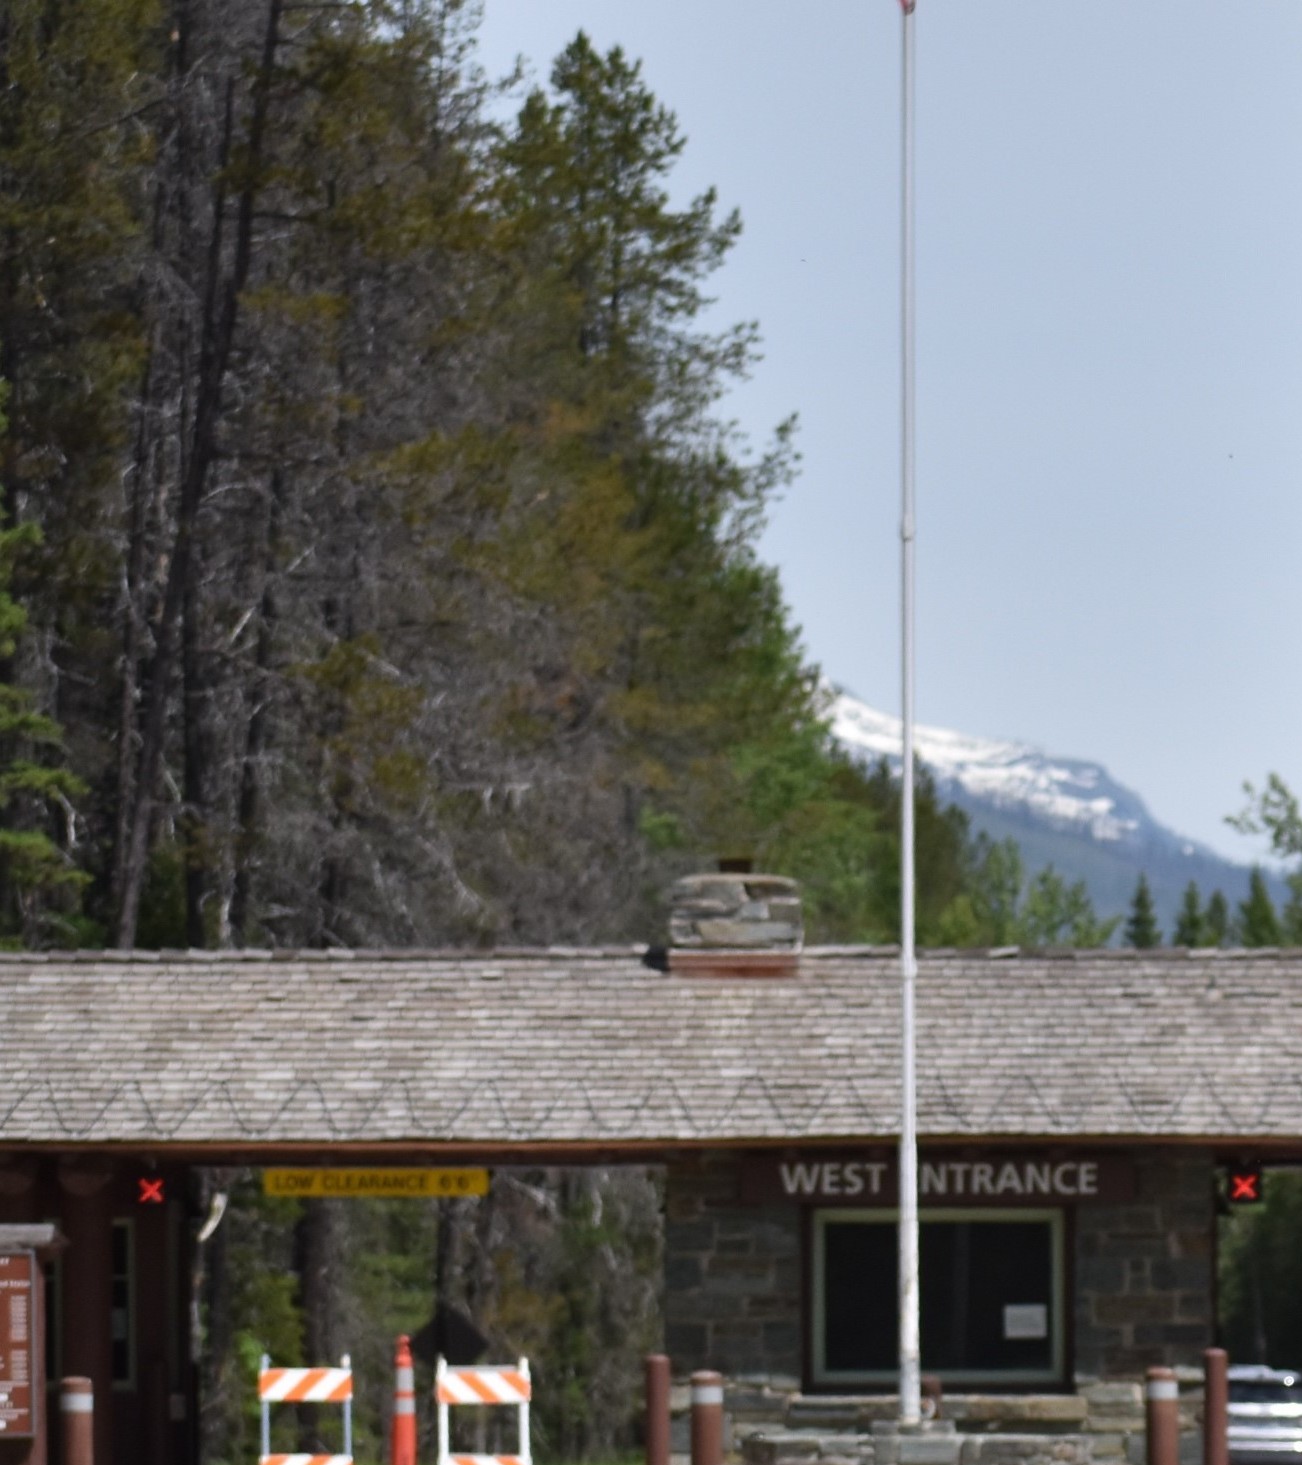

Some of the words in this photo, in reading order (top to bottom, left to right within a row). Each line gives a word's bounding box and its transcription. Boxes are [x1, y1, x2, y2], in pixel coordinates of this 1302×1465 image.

[274, 1174, 314, 1190] LOW
[322, 1174, 426, 1190] CLEARANCE
[779, 1162, 888, 1195] WEST
[920, 1162, 1099, 1195] NTRANCE
